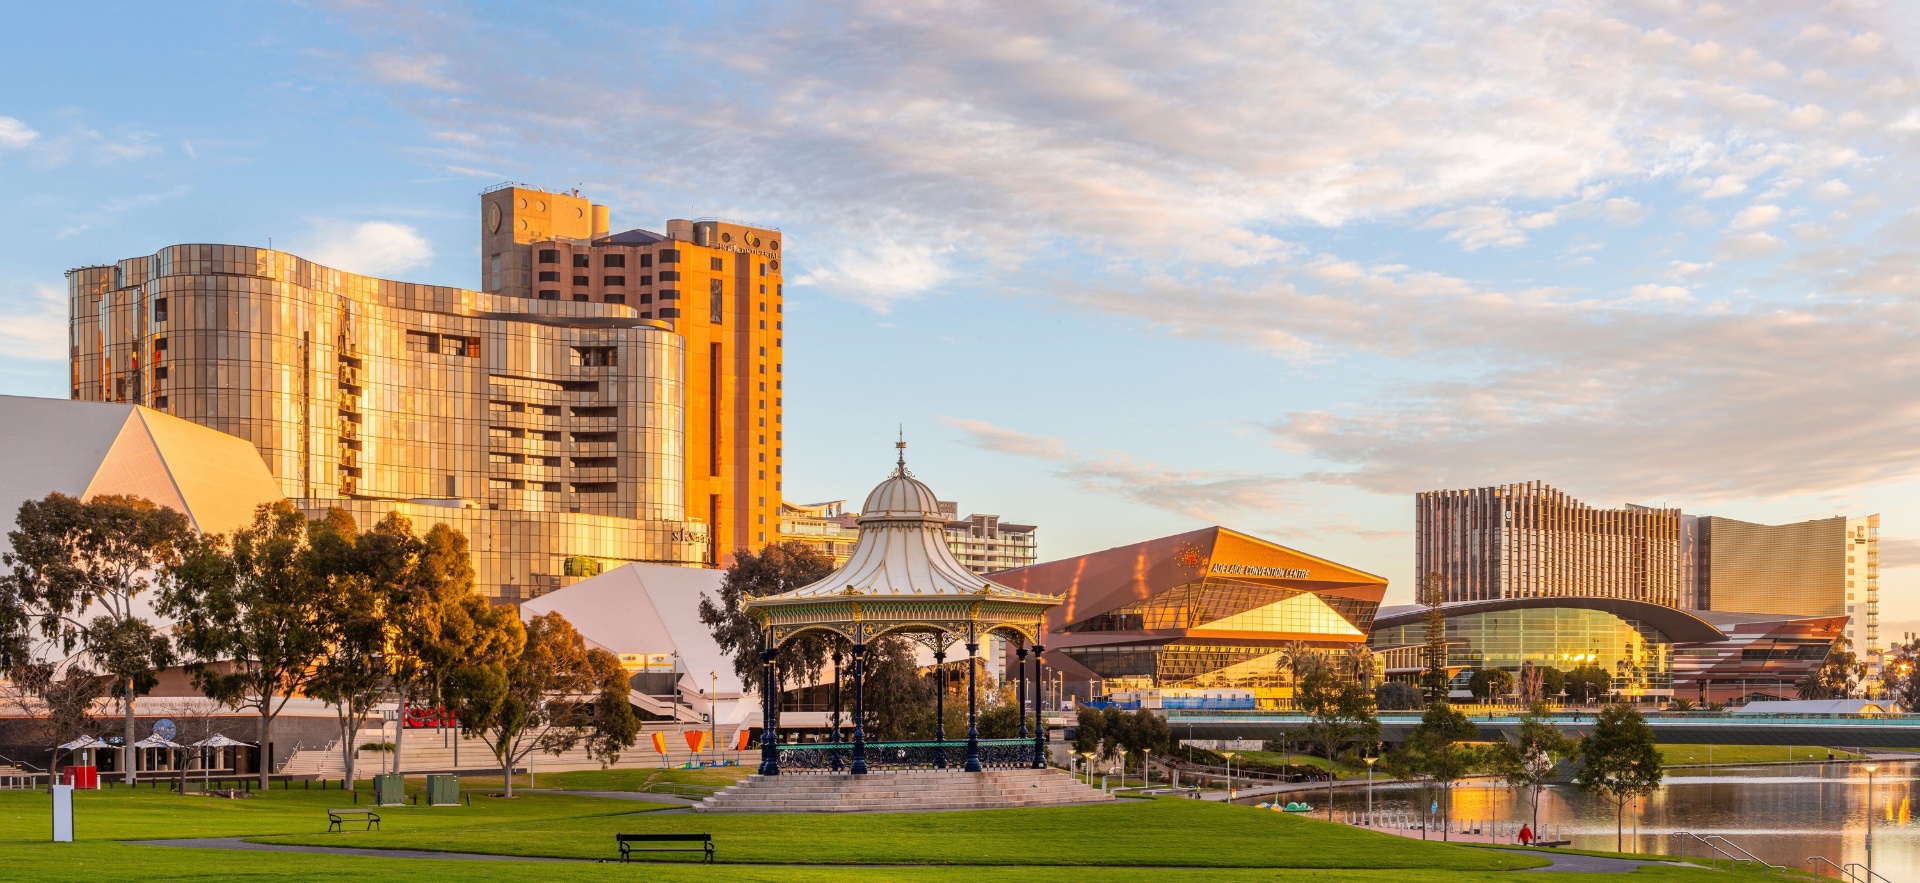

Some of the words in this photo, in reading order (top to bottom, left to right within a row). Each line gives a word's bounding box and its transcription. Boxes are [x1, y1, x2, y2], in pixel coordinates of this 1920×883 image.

[1212, 563, 1245, 575] ADELAIDE
[1245, 565, 1285, 578] CONVENTION
[1285, 568, 1310, 579] CENTRE
